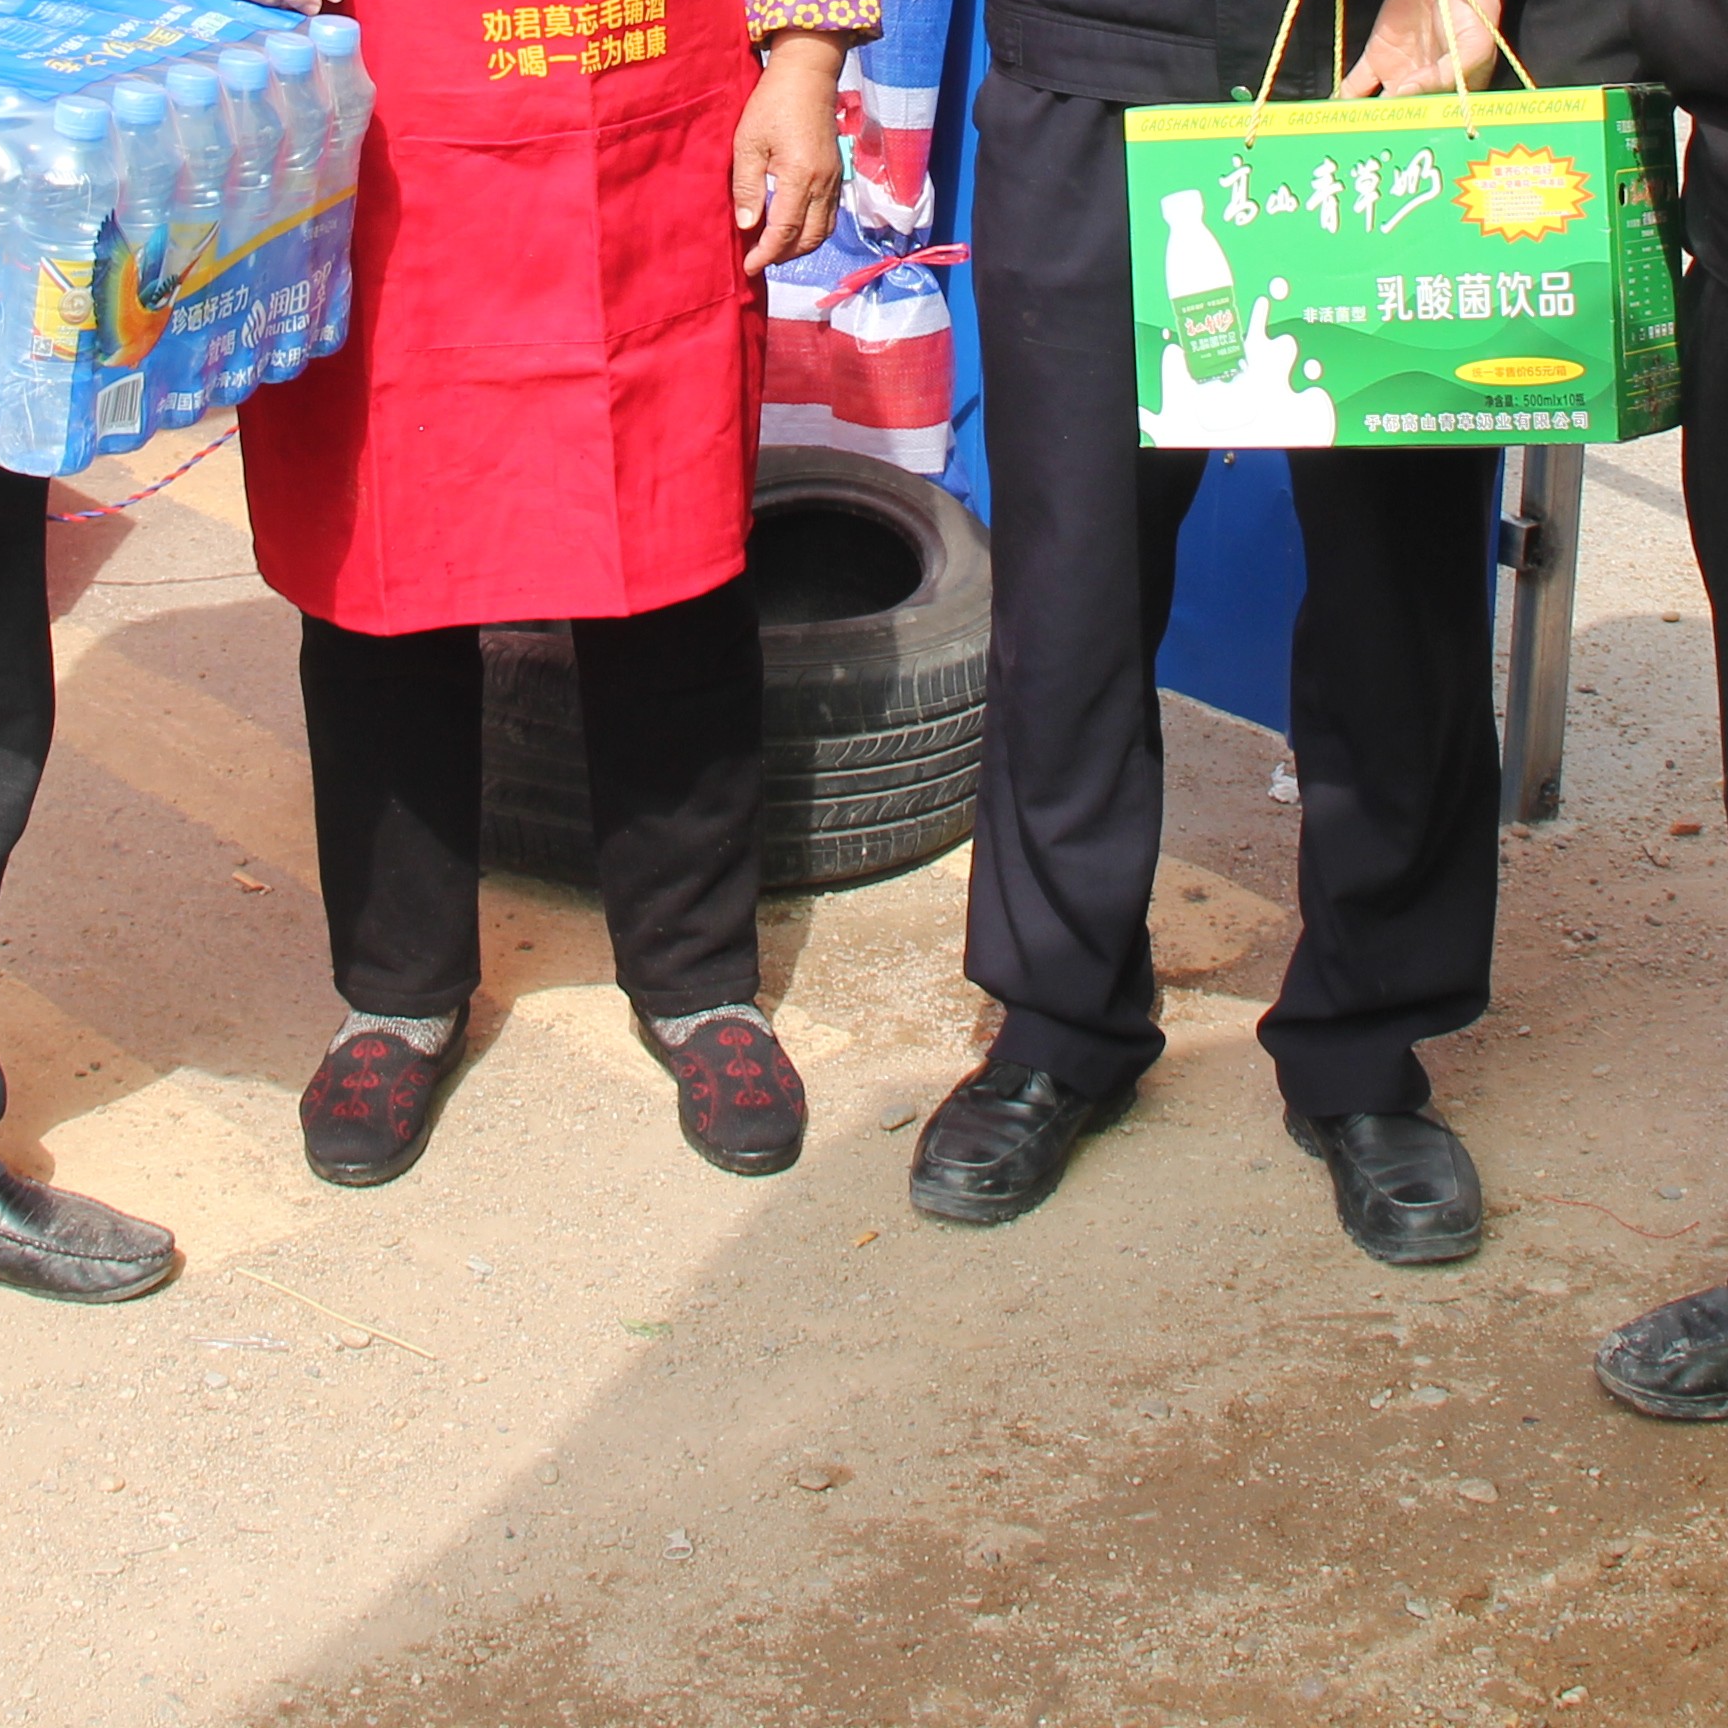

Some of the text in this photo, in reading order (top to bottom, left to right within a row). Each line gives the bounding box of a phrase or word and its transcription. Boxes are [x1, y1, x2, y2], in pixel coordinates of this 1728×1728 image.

[488, 25, 667, 81] 少喝一点为健康
[1140, 113, 1274, 133] GAOSHANQINGCAOAI
[1287, 106, 1427, 127] GAOSHANQINGCAONAI
[1218, 146, 1443, 235] 高山青草奶
[171, 283, 250, 336] 珍硒好活力
[267, 279, 311, 322] 润田
[1302, 271, 1576, 324] 非活菌型 乳酸菌饮品
[1363, 410, 1591, 433] 于都高山青草奶业有限公司
